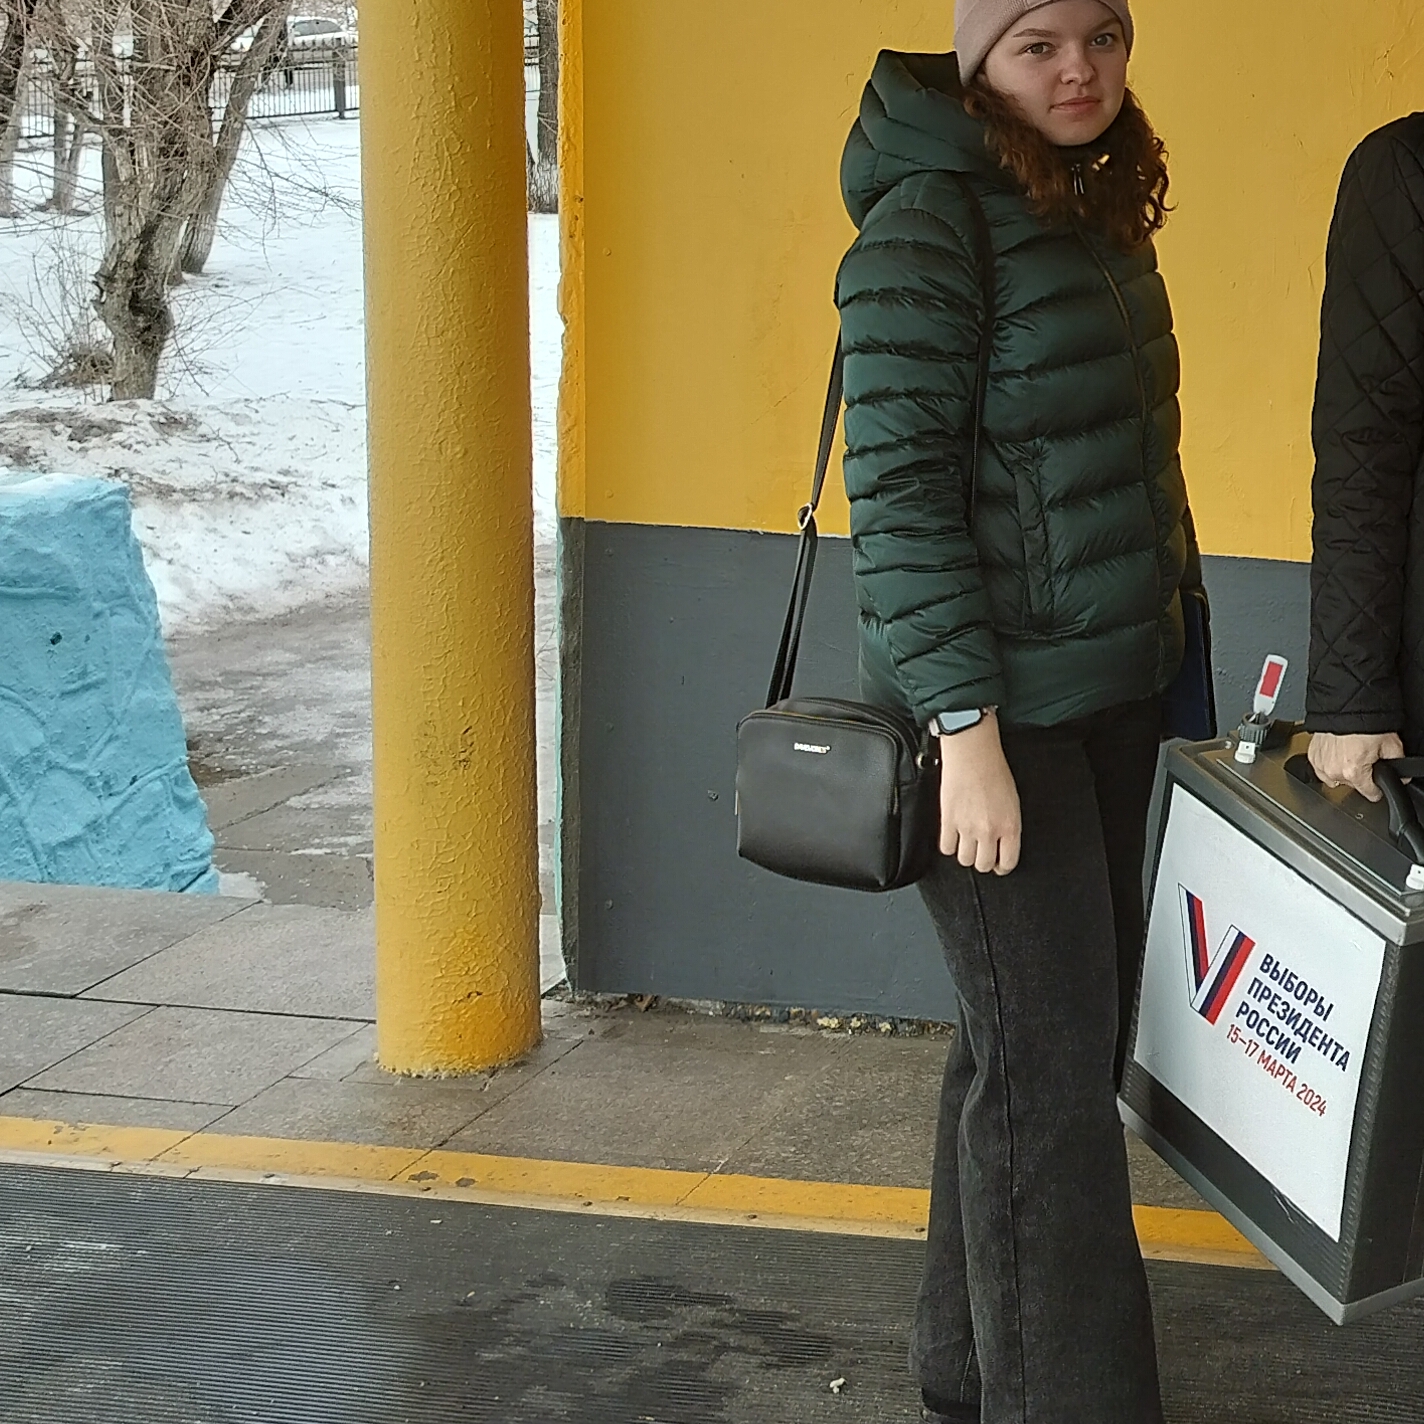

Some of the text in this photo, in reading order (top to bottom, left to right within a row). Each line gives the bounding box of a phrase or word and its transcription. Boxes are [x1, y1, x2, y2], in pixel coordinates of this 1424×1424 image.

[1259, 953, 1334, 1022] ВЫБОРЫ
[1235, 1000, 1302, 1065] РОССИИ
[1247, 977, 1351, 1072] ПРЕЗИДЕНТА
[1256, 1049, 1298, 1093] МАРТА
[1296, 1083, 1327, 1117] 2024
